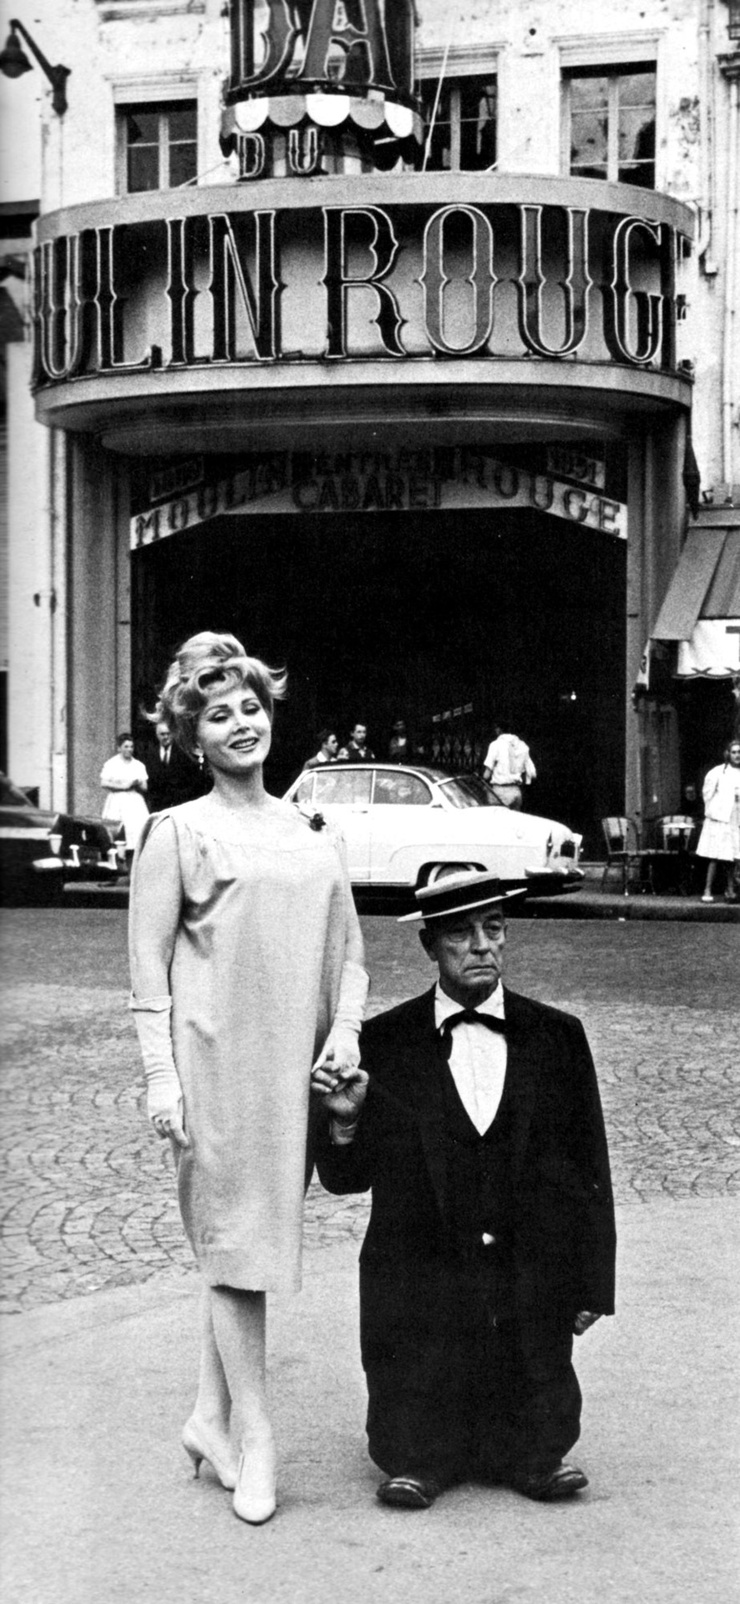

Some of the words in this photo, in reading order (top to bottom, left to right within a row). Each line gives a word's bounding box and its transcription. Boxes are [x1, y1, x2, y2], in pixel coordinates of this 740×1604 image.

[237, 128, 319, 178] DU
[135, 457, 287, 547] MOULIN
[460, 450, 621, 535] ROUGE
[292, 476, 441, 511] CABARET
